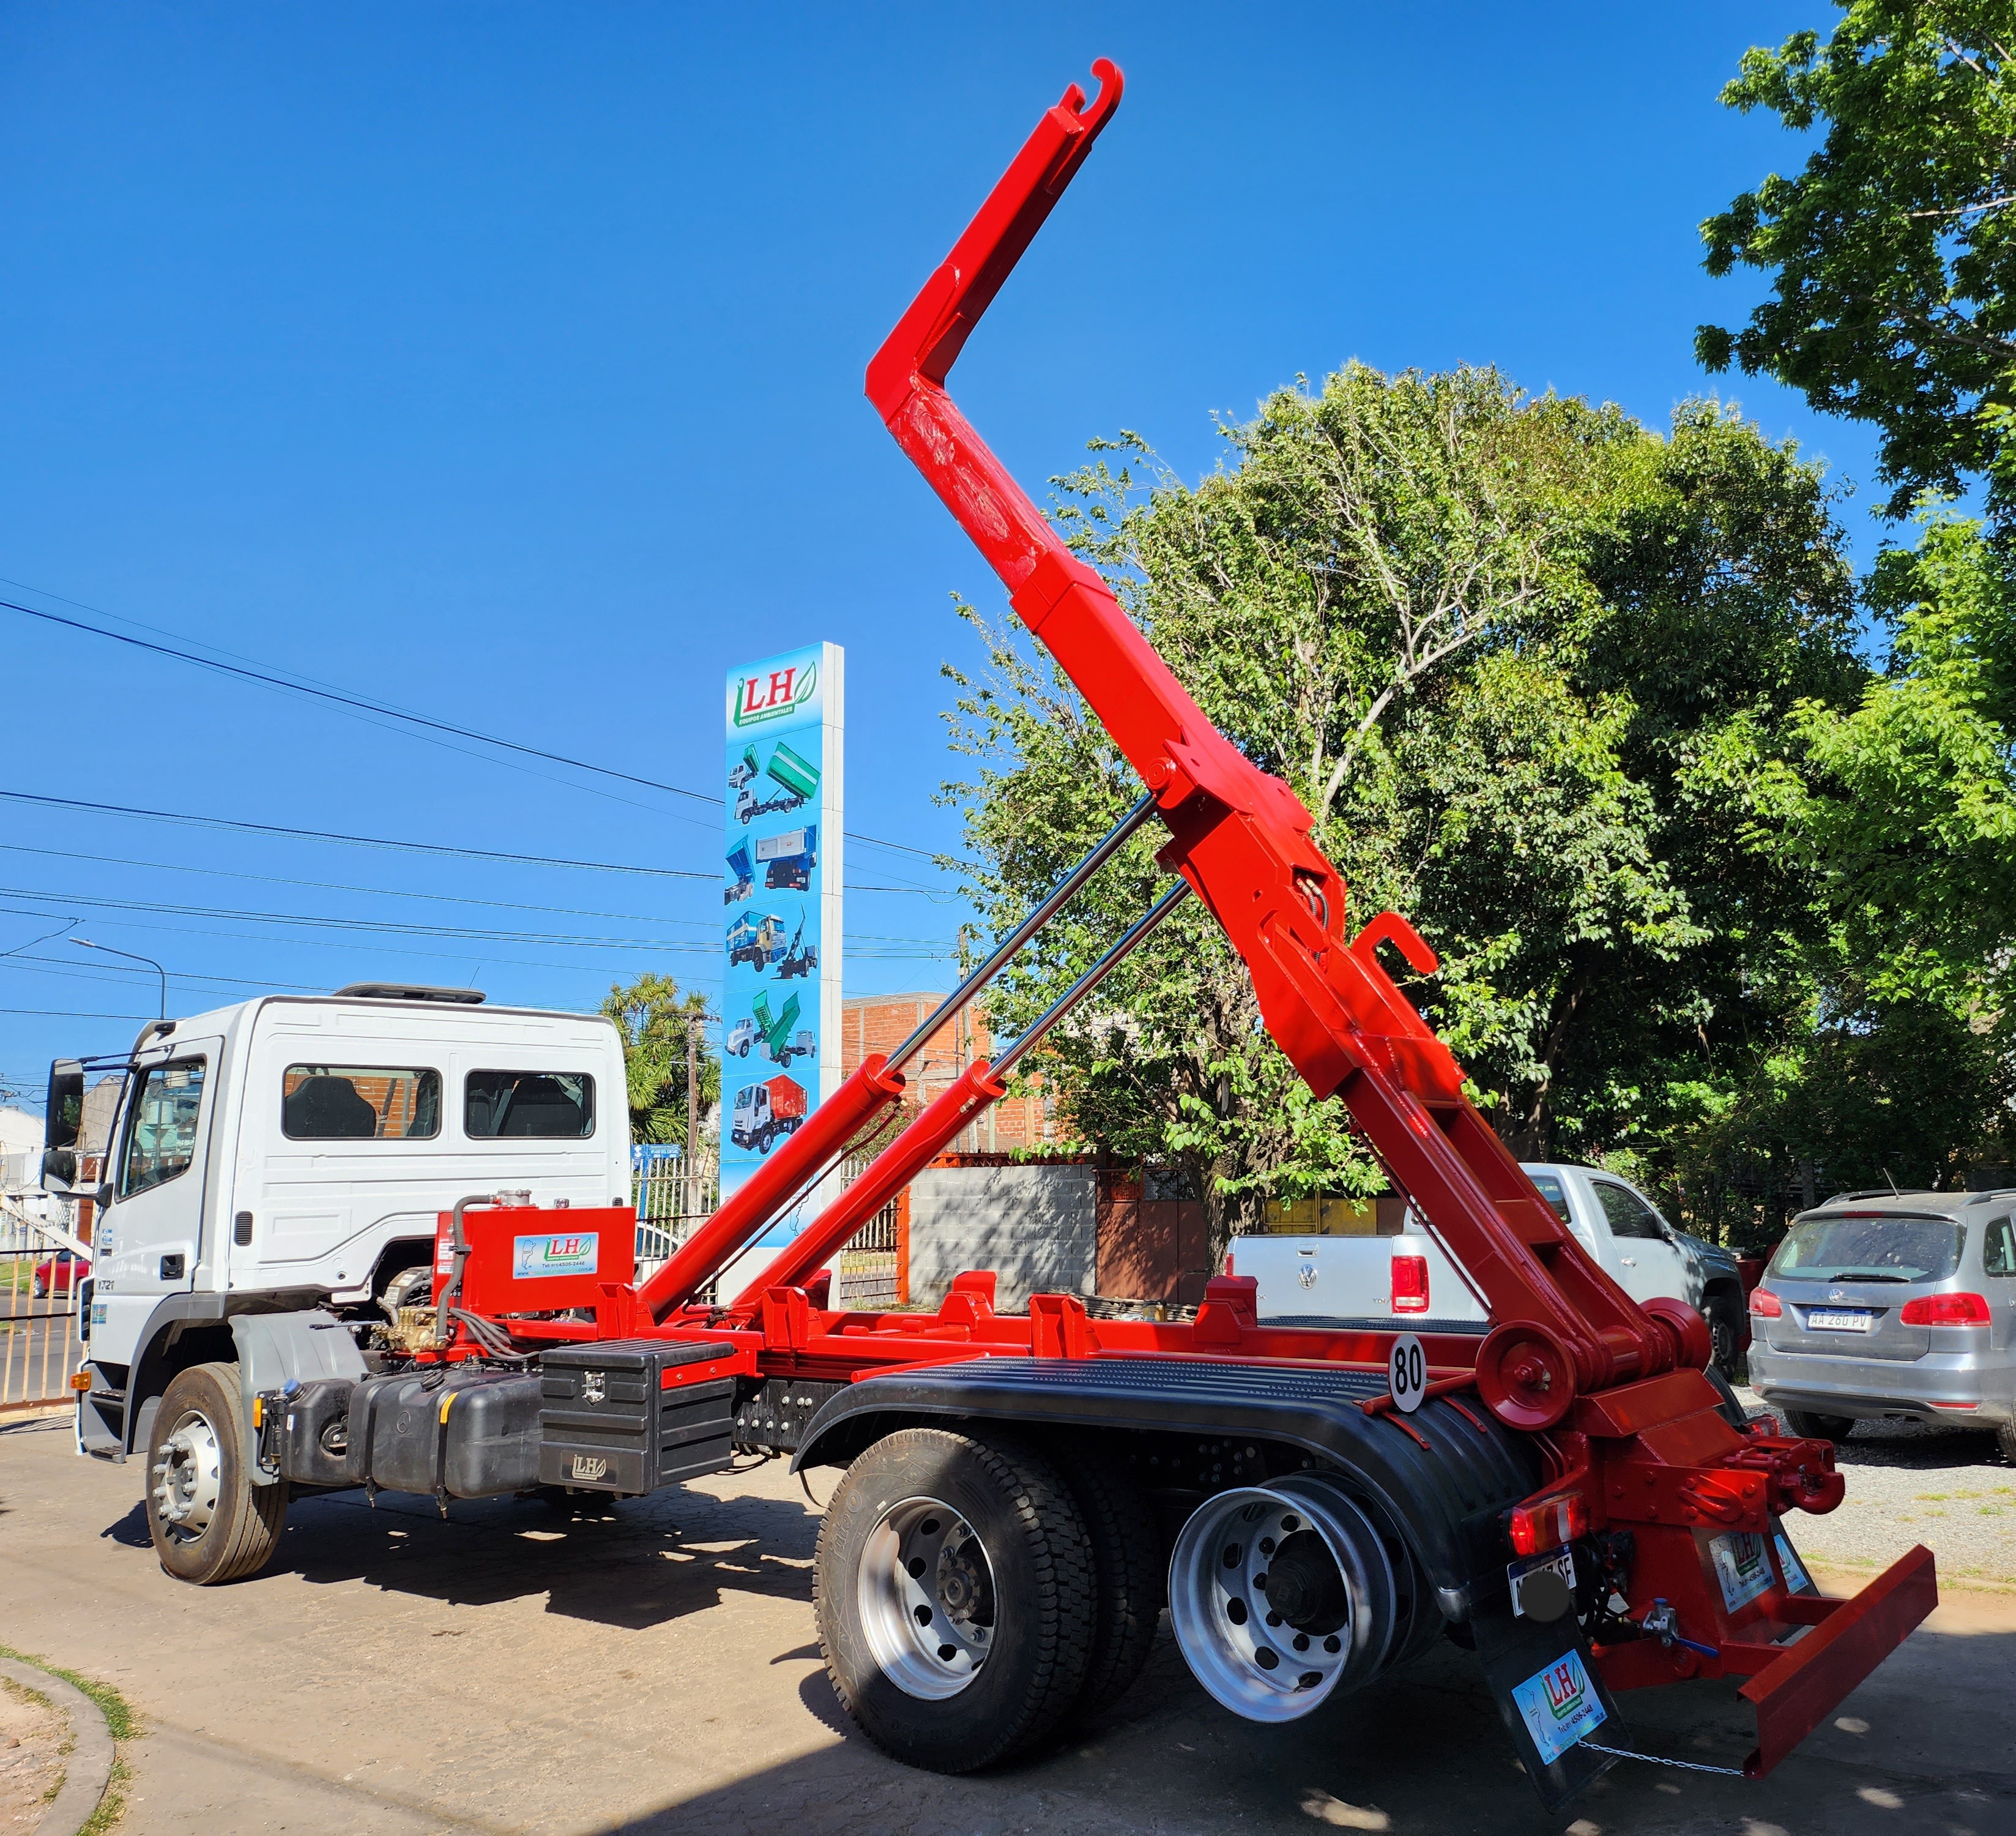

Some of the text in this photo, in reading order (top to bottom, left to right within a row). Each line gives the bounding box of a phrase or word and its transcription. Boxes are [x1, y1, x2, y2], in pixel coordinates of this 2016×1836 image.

[743, 667, 796, 713] LH
[738, 706, 793, 725] EQUIPOS AMBIENTALES
[550, 1239, 579, 1255] LH
[1811, 1313, 1866, 1327] AA 260 PV
[1395, 1344, 1421, 1395] 80
[576, 1457, 598, 1473] LH
[1544, 1663, 1577, 1706] LH
